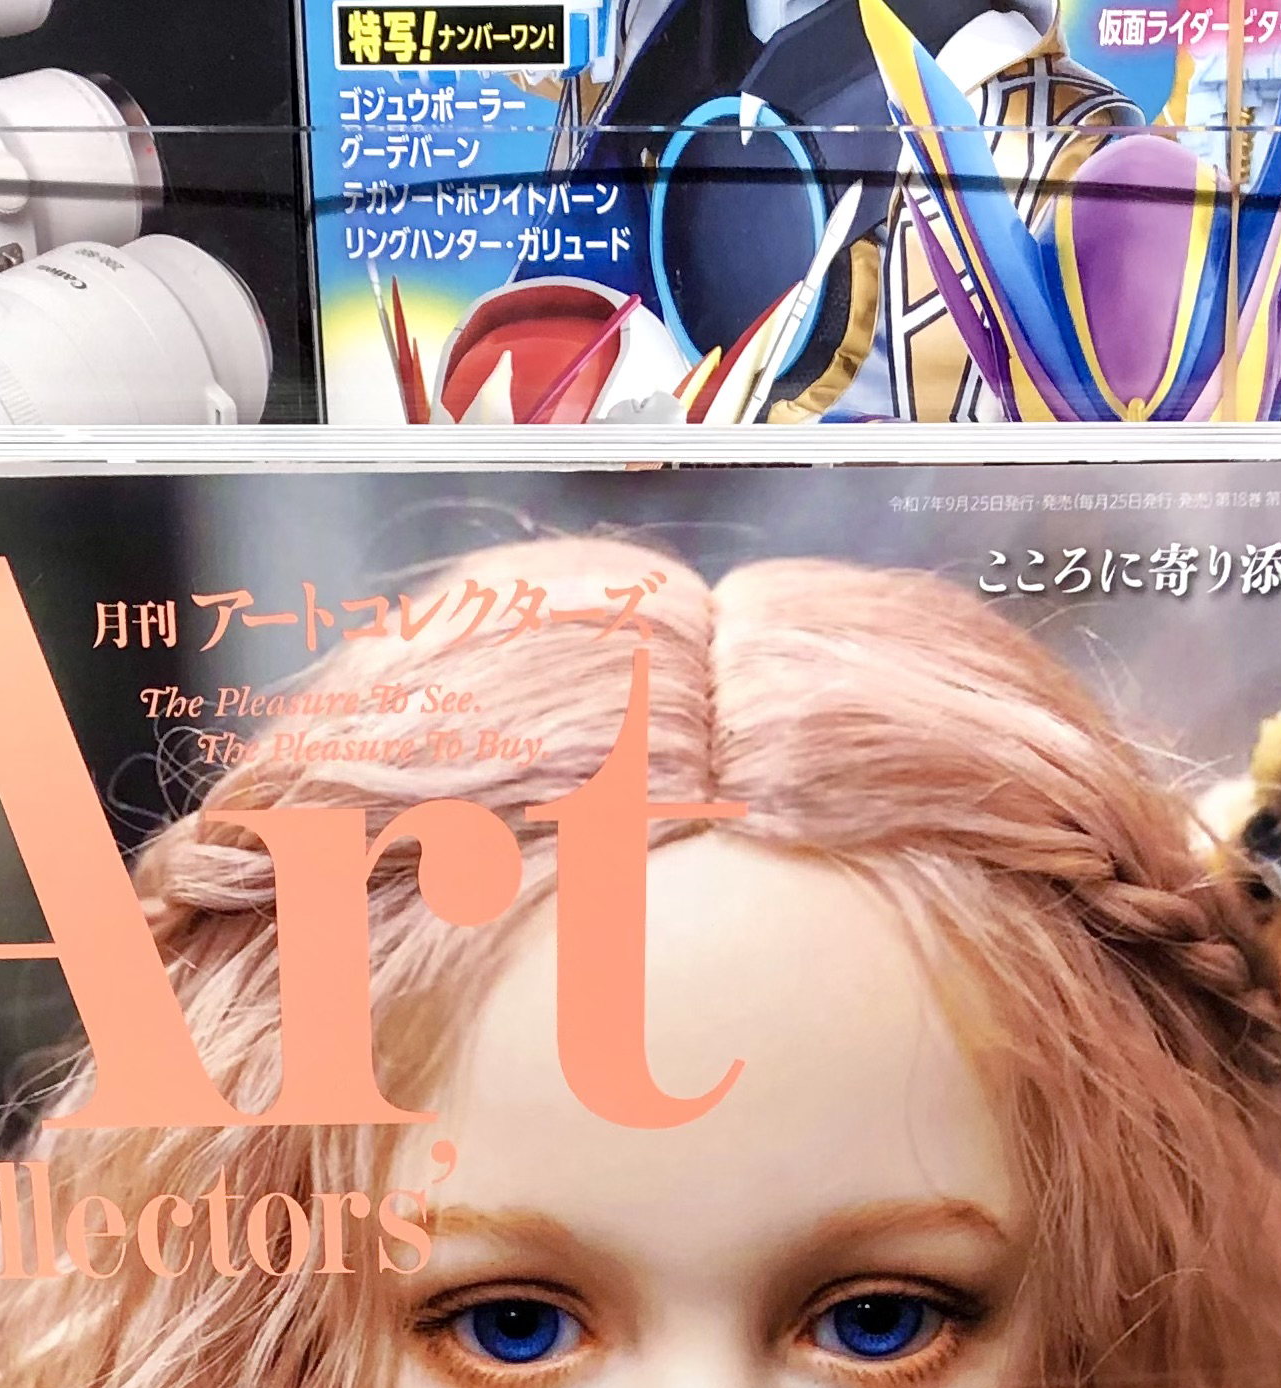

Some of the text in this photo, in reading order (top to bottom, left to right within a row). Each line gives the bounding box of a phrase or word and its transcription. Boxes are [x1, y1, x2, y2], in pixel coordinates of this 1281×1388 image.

[339, 88, 526, 122] ゴジュウポーラー
[340, 135, 481, 169] グーデバーン
[343, 183, 618, 217] テガソードホワイトバーン
[345, 227, 631, 262] リングハンター・ガリュード
[93, 570, 668, 653] 月刊 アートコレクターズ
[140, 686, 204, 719] The
[216, 686, 359, 718] Pleasure
[197, 734, 257, 765] The
